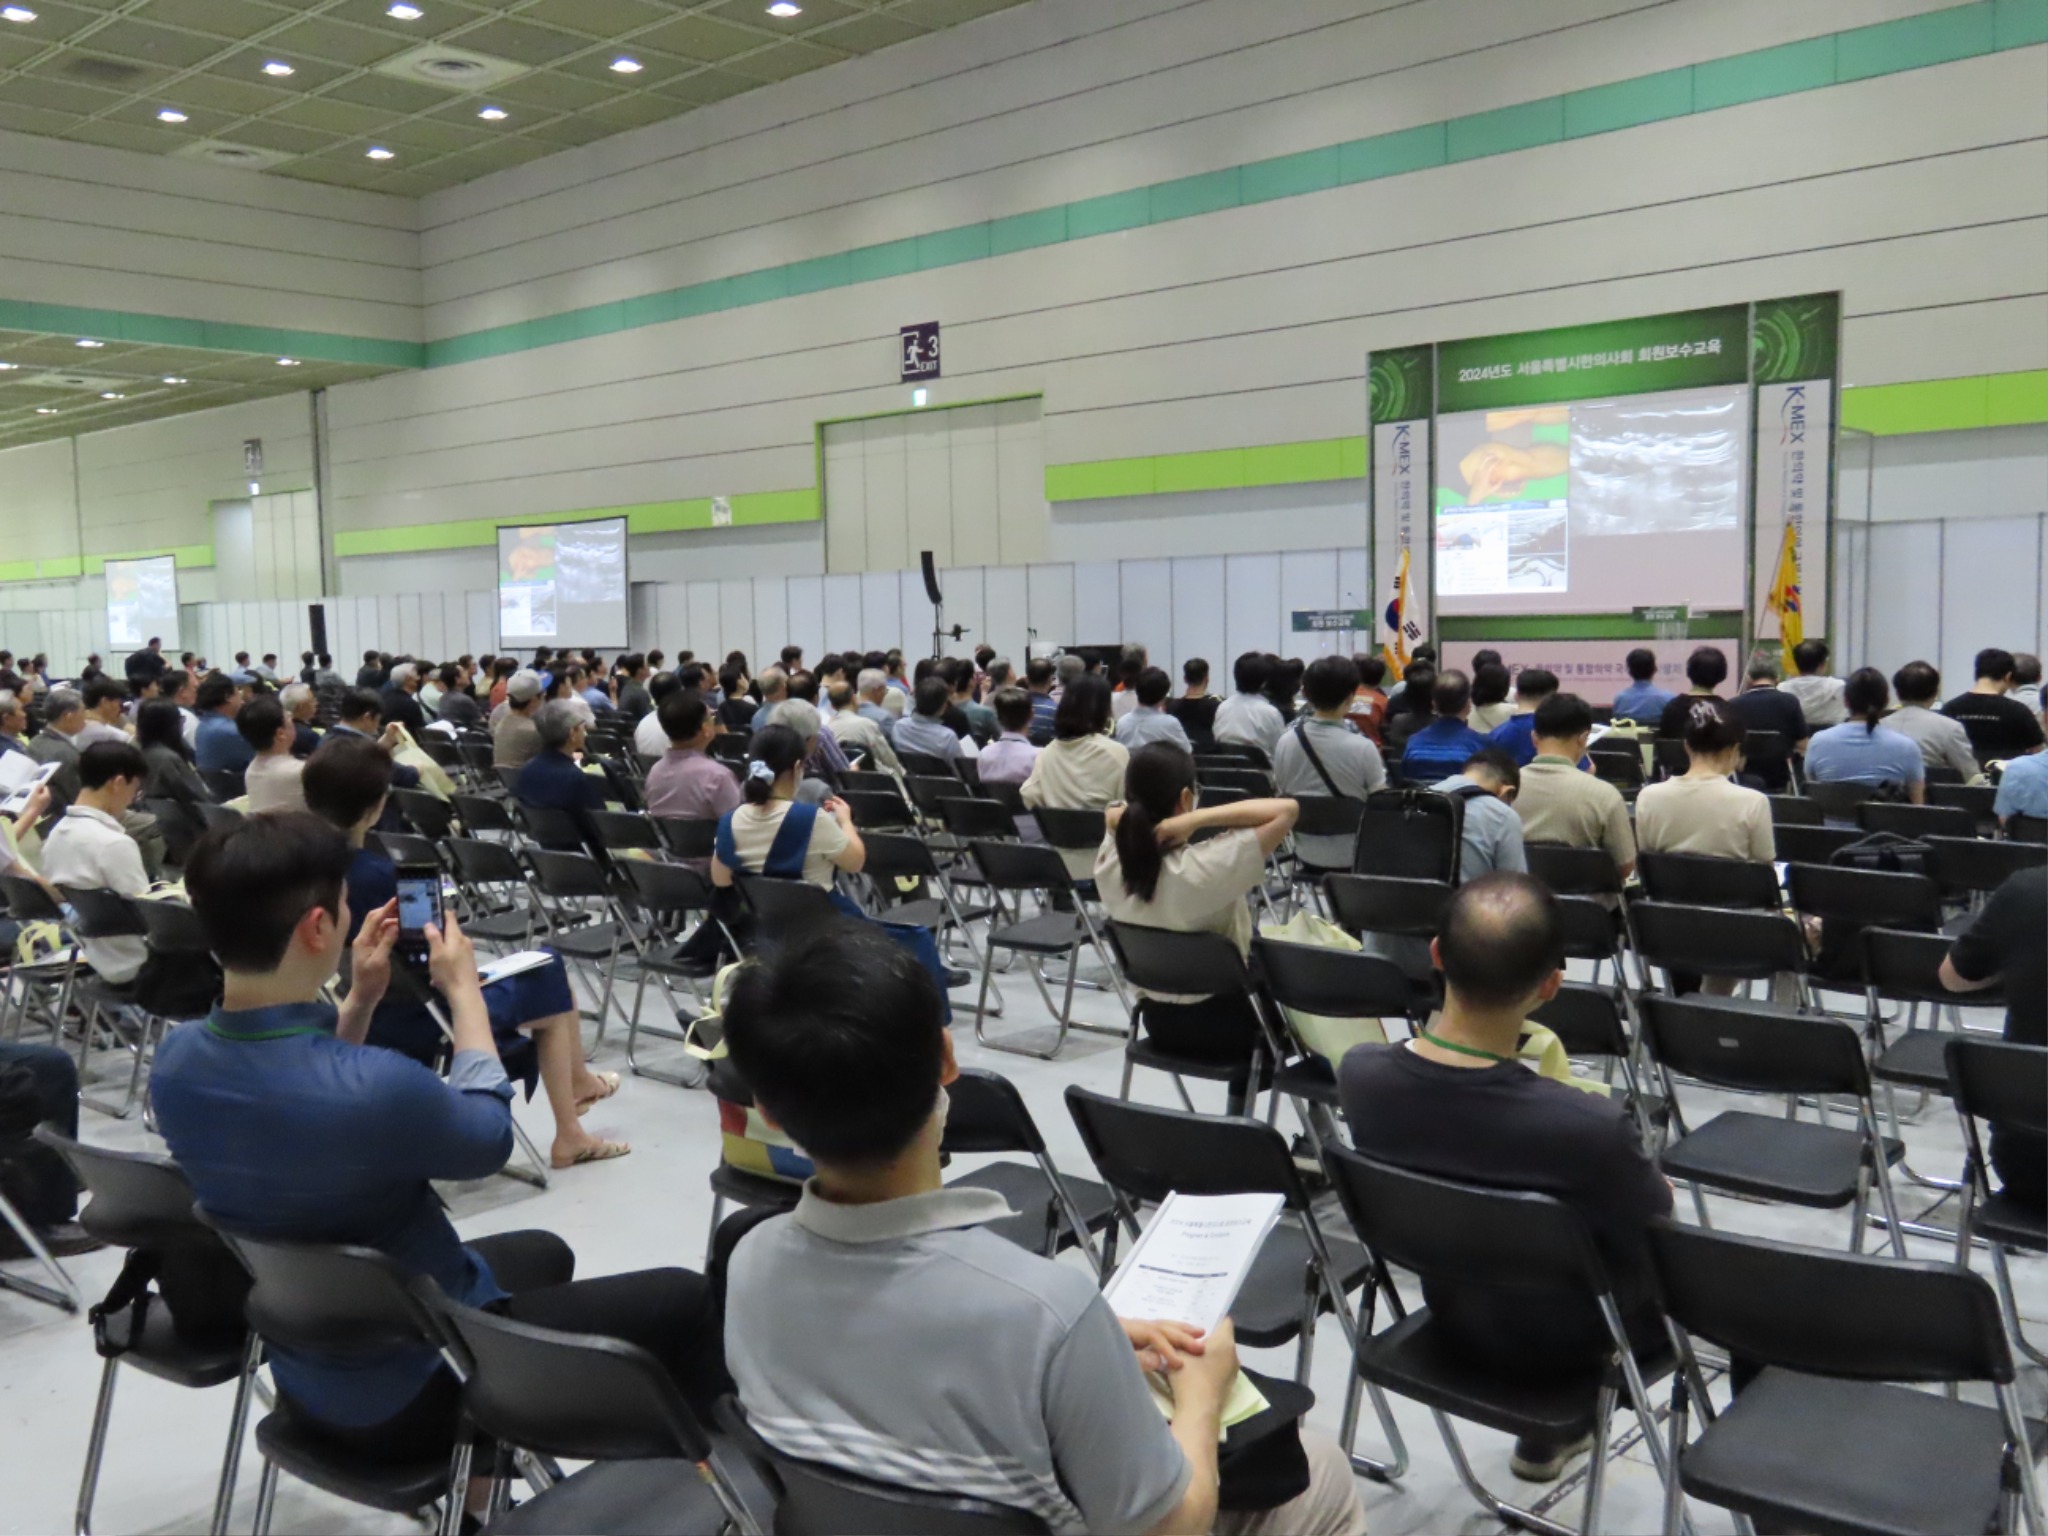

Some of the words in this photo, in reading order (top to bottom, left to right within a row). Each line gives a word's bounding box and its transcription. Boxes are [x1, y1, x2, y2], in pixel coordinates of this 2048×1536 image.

[921, 360, 937, 372] EXIT
[928, 335, 938, 357] 3
[1458, 364, 1512, 383] 2024년도
[1638, 339, 1722, 363] 회원보수교육
[1784, 386, 1805, 444] K-MEX
[1394, 425, 1411, 475] K-MEX
